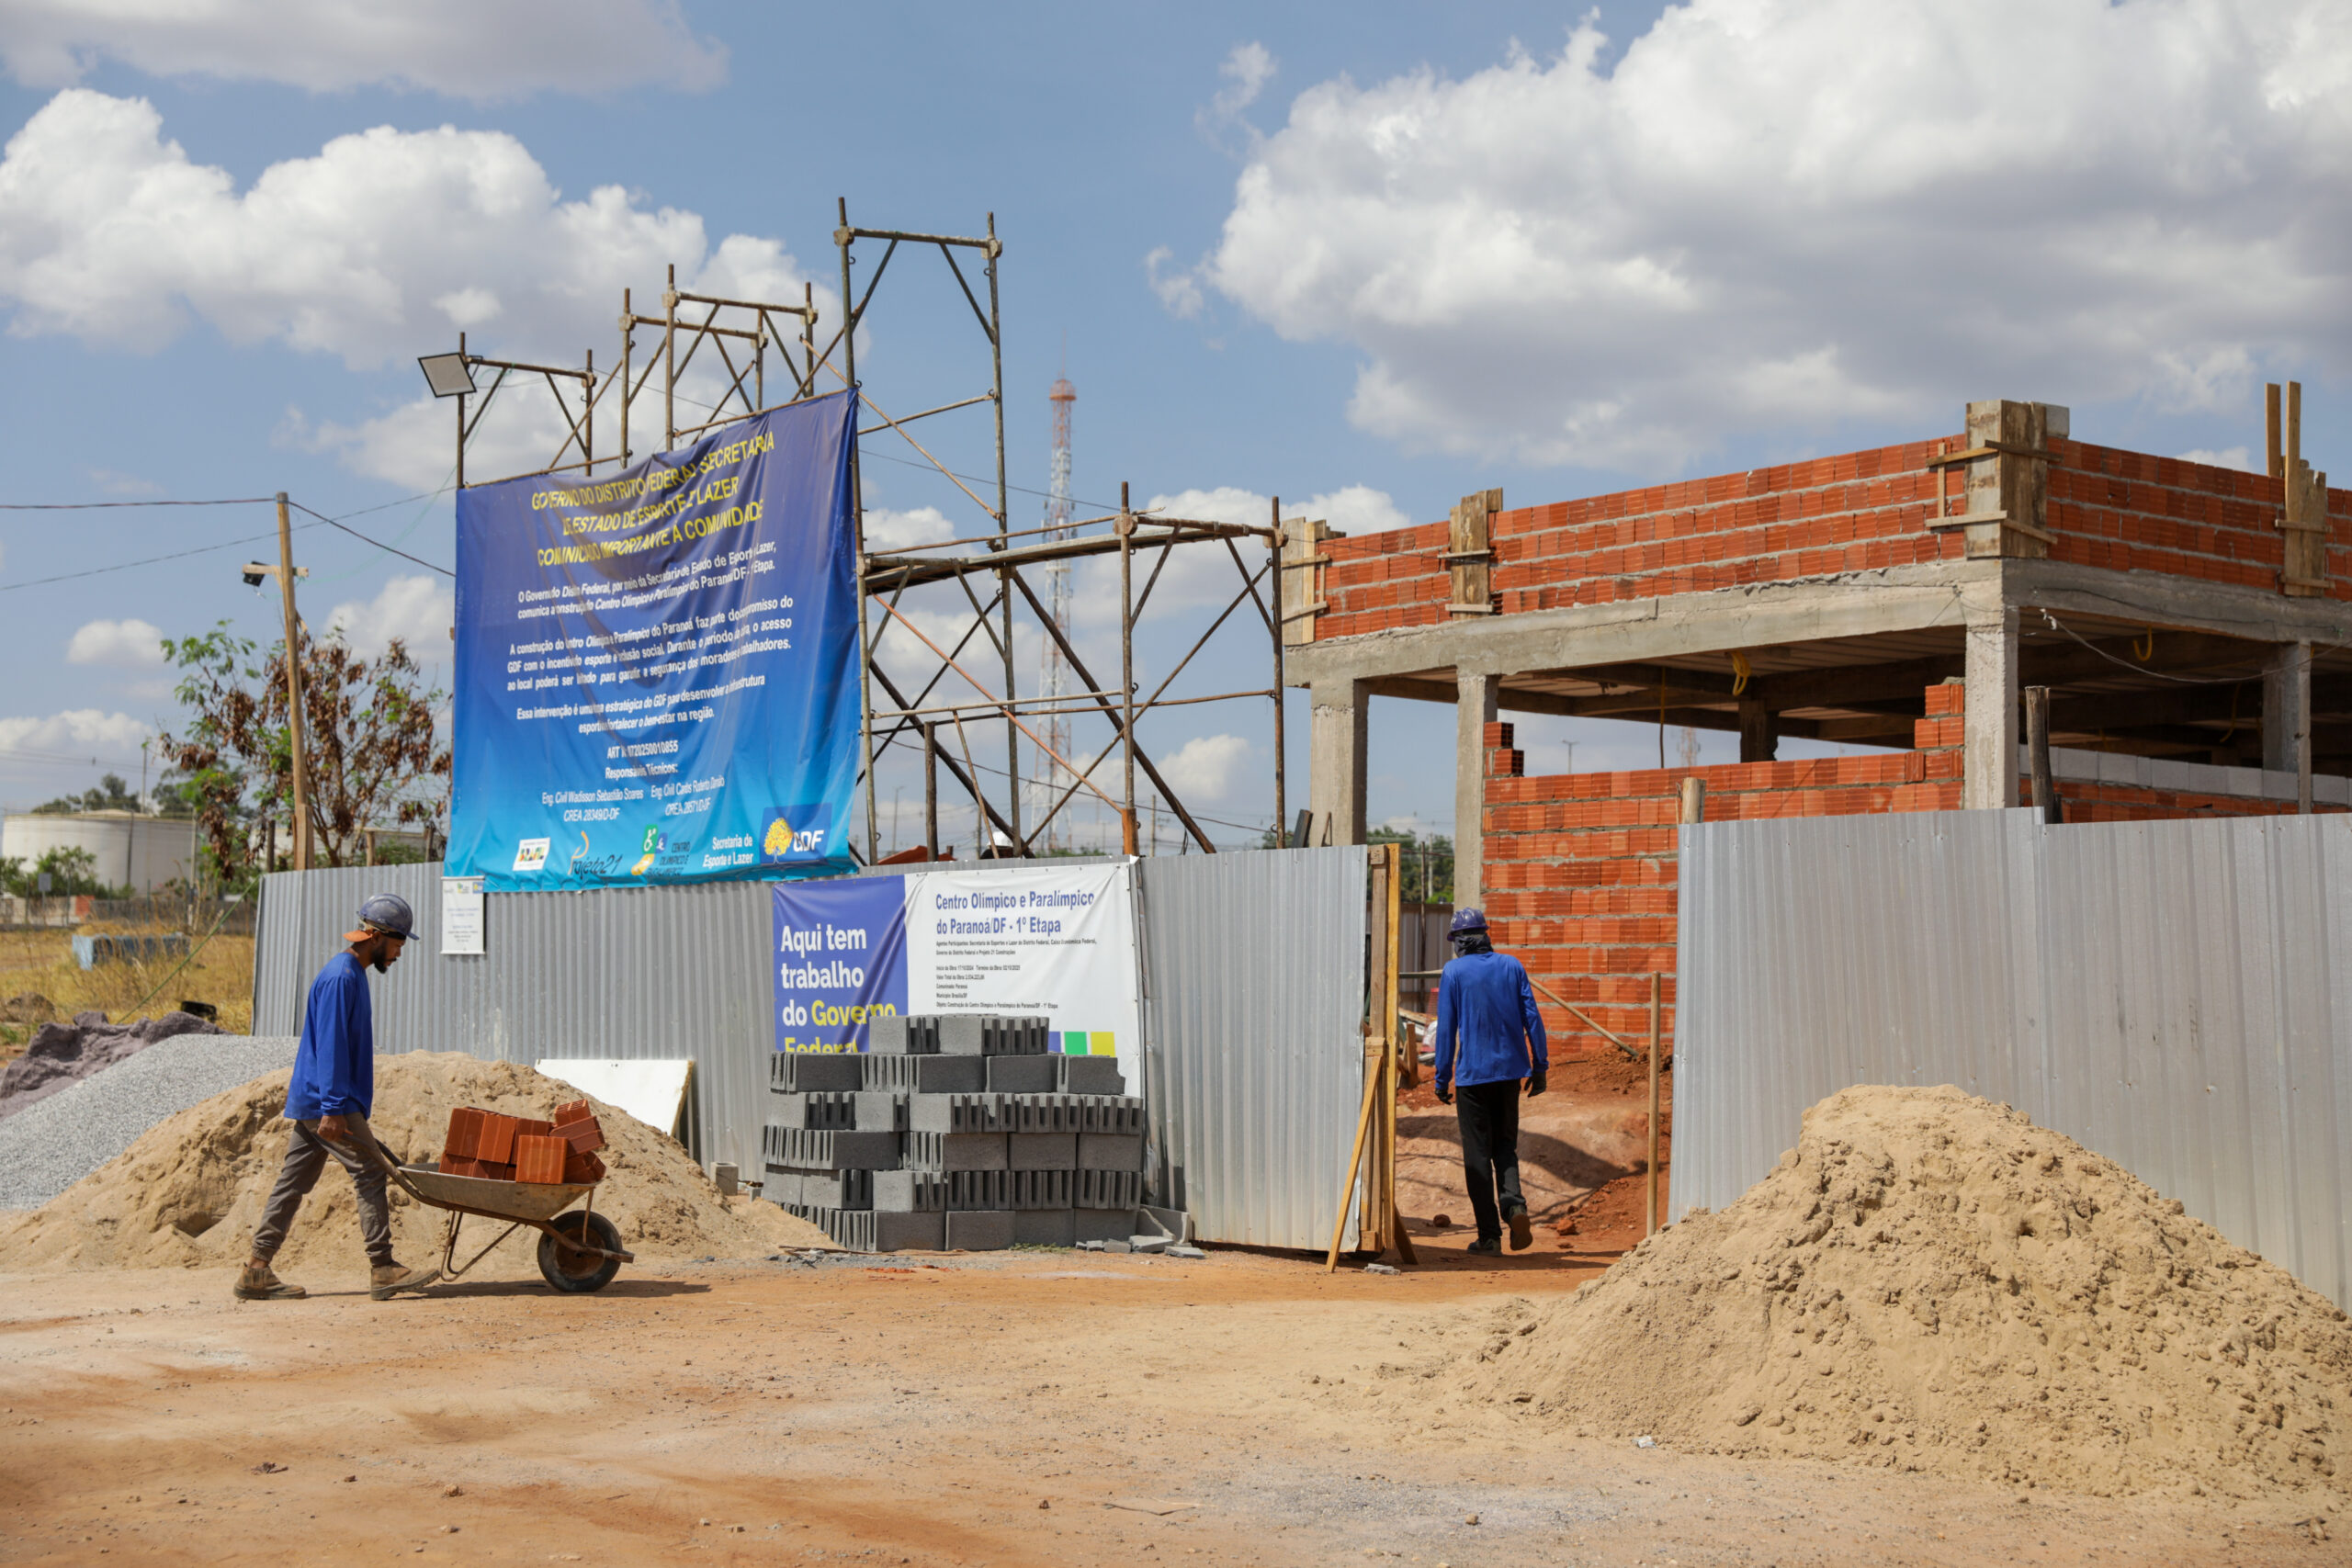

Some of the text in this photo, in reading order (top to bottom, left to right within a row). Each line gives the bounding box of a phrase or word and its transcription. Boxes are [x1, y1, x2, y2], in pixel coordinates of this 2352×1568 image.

[595, 478, 646, 503] DISTRITO
[699, 431, 775, 474] SECRETARIA
[572, 513, 621, 534] ESTADO
[622, 510, 637, 529] DE
[696, 476, 740, 505] LAZER
[714, 555, 727, 568] de
[690, 578, 700, 591] do
[555, 637, 564, 650] do
[651, 625, 662, 637] do
[662, 617, 694, 635] Paranoá
[695, 615, 709, 628] faz
[780, 594, 794, 608] do
[507, 660, 522, 673] GDF
[667, 637, 696, 654] Durante
[753, 623, 759, 632] o
[761, 618, 792, 632] acesso
[562, 676, 573, 686] ser
[599, 672, 616, 685] para
[677, 711, 687, 722] na
[712, 833, 753, 851] Secretaria de
[793, 829, 825, 852] GDF
[733, 852, 753, 865] Lazer
[935, 893, 968, 910] Centro
[1020, 895, 1026, 908] e
[937, 919, 948, 934] do
[950, 917, 1007, 935] Paranoá/DF
[1030, 917, 1061, 937] Etapa
[781, 923, 867, 959] Aqui tem
[781, 960, 865, 989] trabalho
[783, 999, 808, 1027] do
